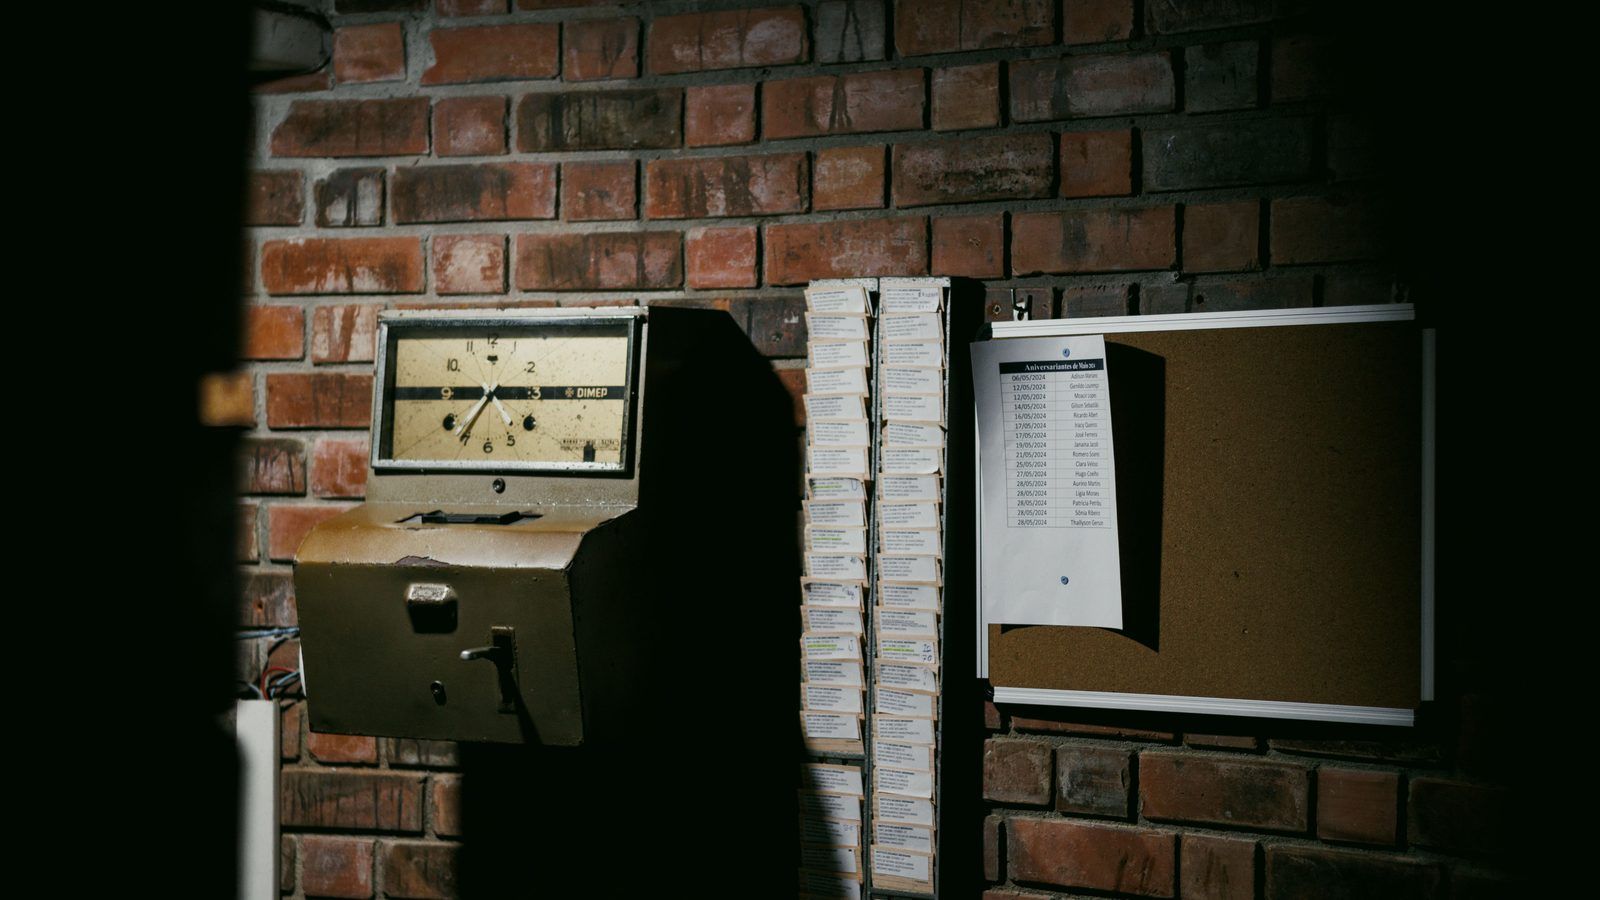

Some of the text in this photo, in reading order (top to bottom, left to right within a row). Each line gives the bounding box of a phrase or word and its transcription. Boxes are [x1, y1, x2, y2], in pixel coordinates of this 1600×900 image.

[486, 334, 498, 345] 12
[466, 342, 474, 352] 11
[447, 358, 458, 371] 10
[527, 361, 536, 373] 2
[1024, 362, 1072, 371] Aniversariantes
[441, 387, 451, 400] 9
[531, 387, 541, 399] 3
[576, 388, 608, 398] DIMEP
[461, 434, 470, 446] 7
[506, 435, 515, 446] 5
[482, 442, 493, 454] 6
